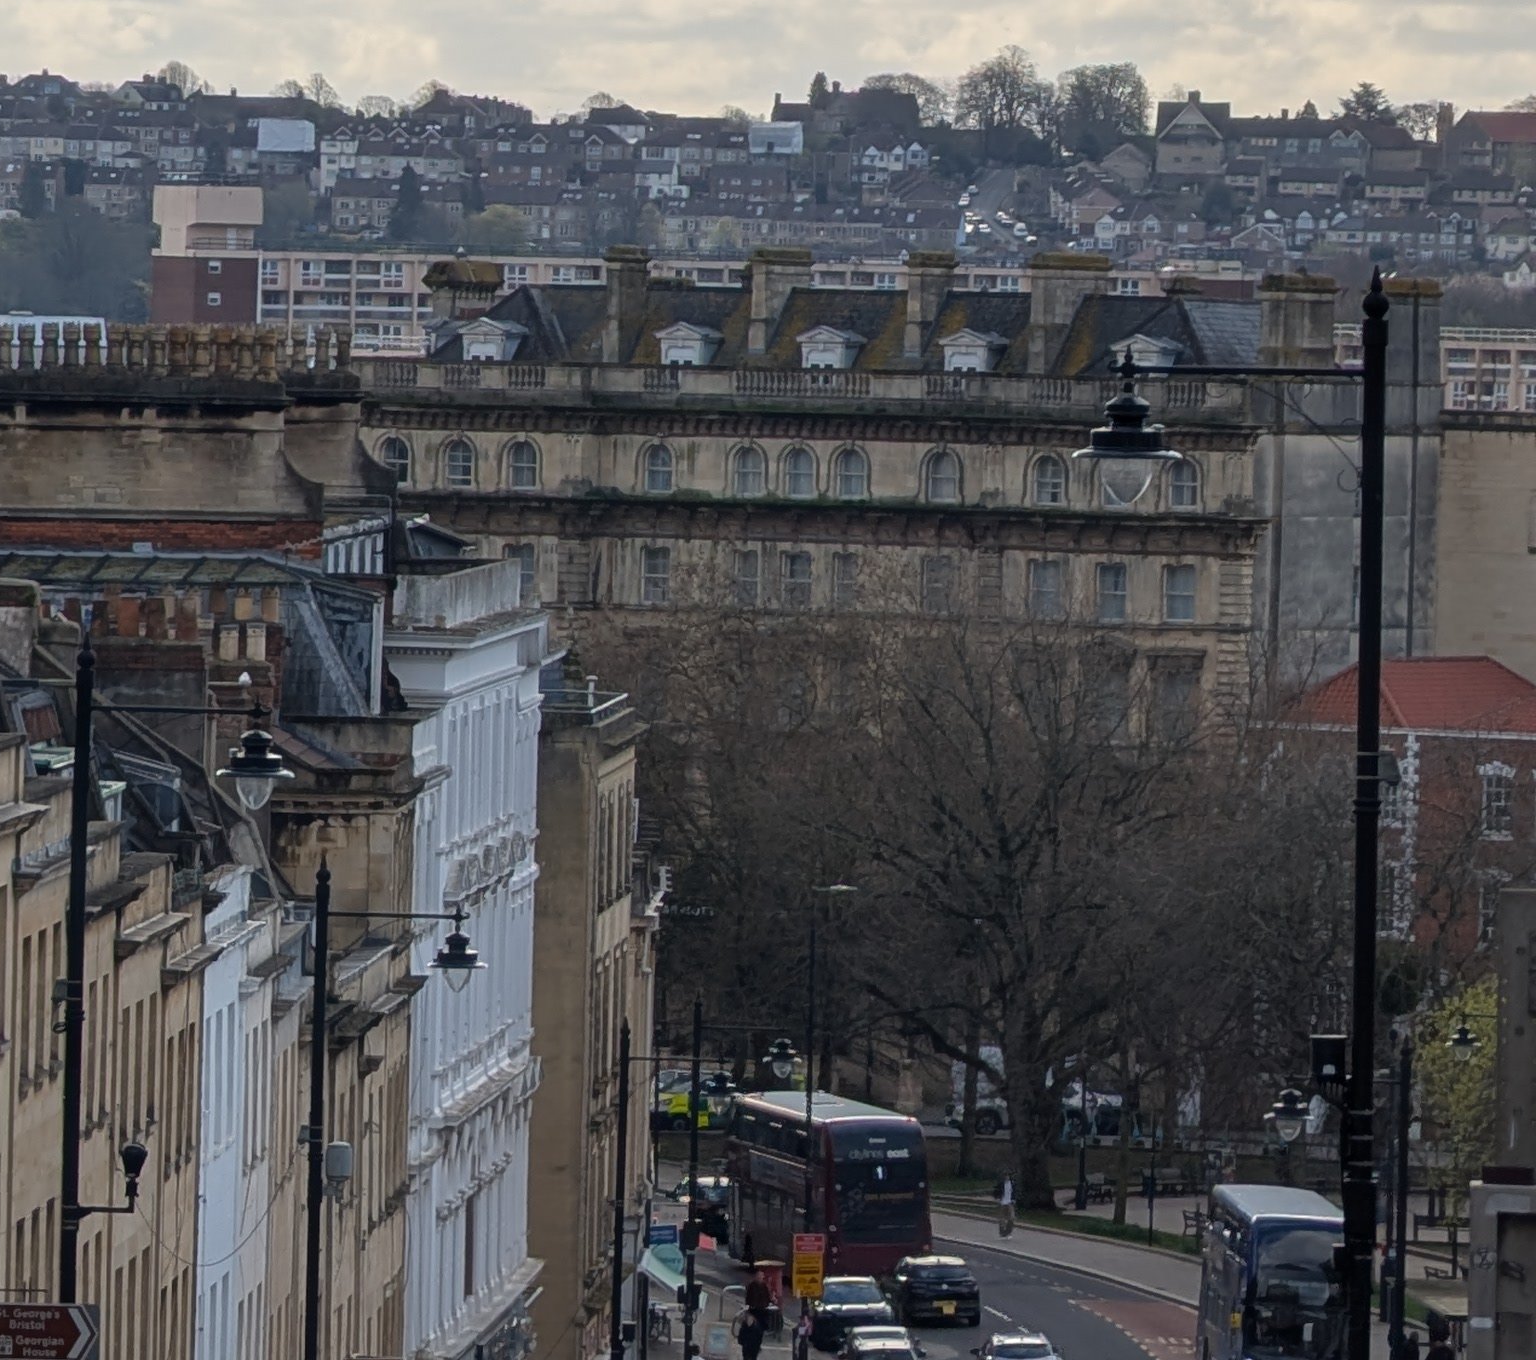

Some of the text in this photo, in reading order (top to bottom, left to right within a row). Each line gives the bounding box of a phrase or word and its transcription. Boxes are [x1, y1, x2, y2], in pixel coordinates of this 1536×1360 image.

[13, 1308, 60, 1320] George's
[9, 1319, 46, 1330] Bristol
[15, 1335, 65, 1347] Georgian
[22, 1346, 57, 1357] House
